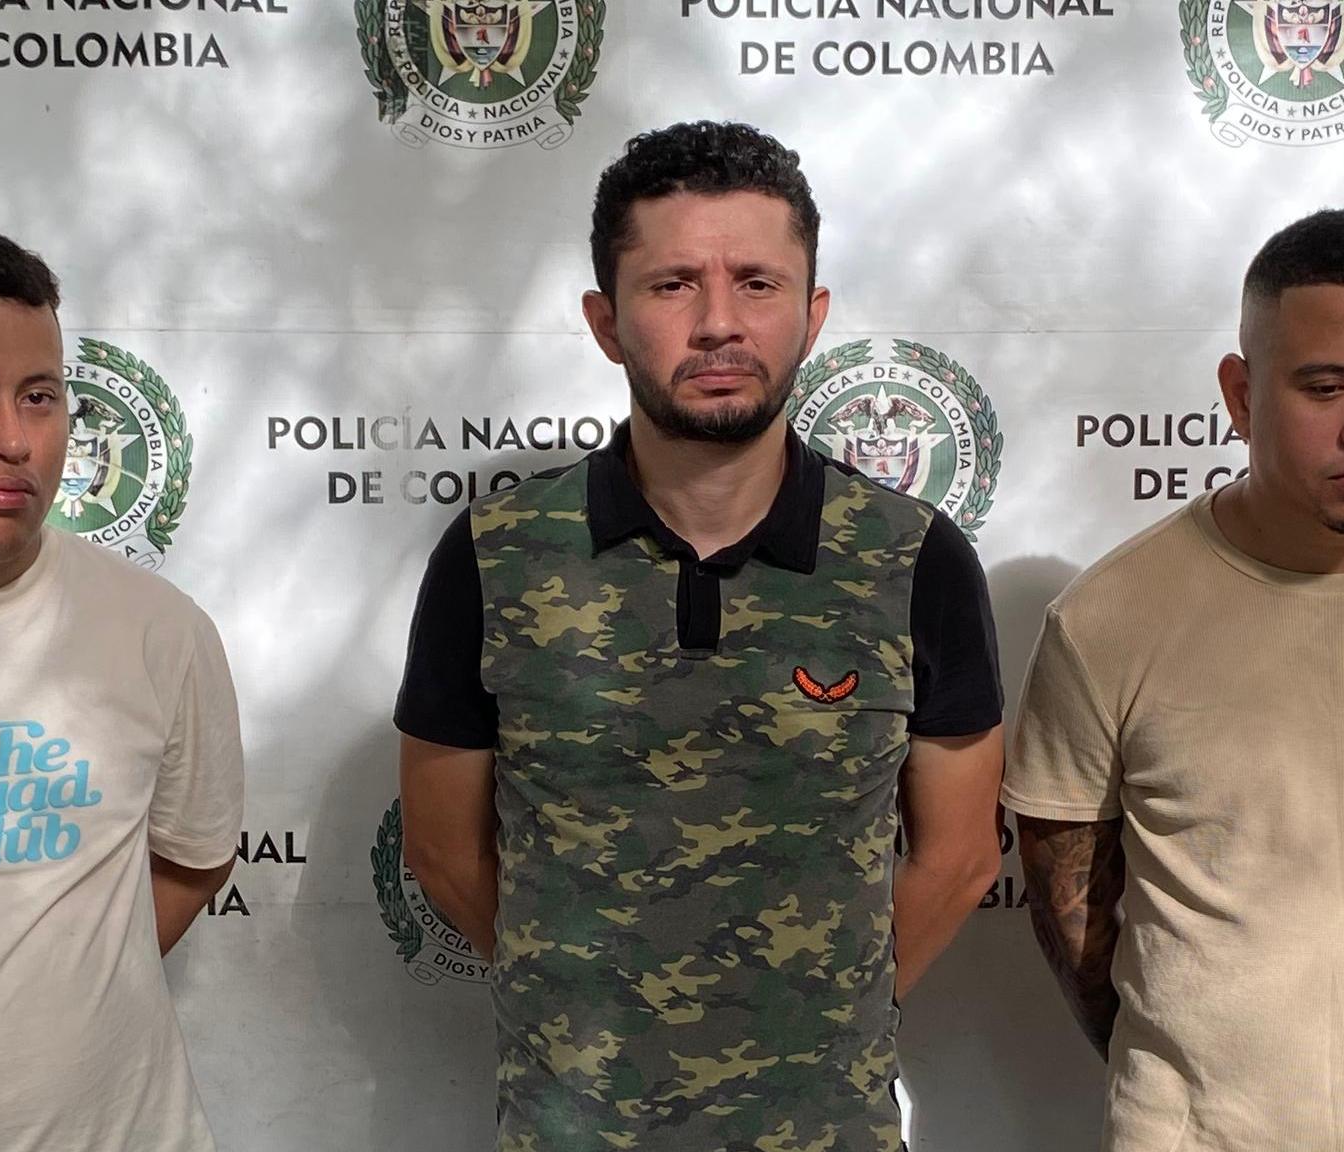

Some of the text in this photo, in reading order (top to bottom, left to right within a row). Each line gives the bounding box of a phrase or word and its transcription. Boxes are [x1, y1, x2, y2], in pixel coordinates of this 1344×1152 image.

[741, 40, 1054, 75] DE COLOMBIA
[484, 63, 567, 119] NACIONAL
[420, 113, 546, 143] DIOS PATRIA
[1239, 113, 1282, 138] DIOS
[106, 377, 164, 472] COLOMBIA
[268, 405, 446, 451] POLICÍA
[873, 367, 972, 471] DE COLOMBIA
[328, 471, 383, 505] DE
[1134, 468, 1188, 500] DE
[434, 952, 476, 977] DIOS
